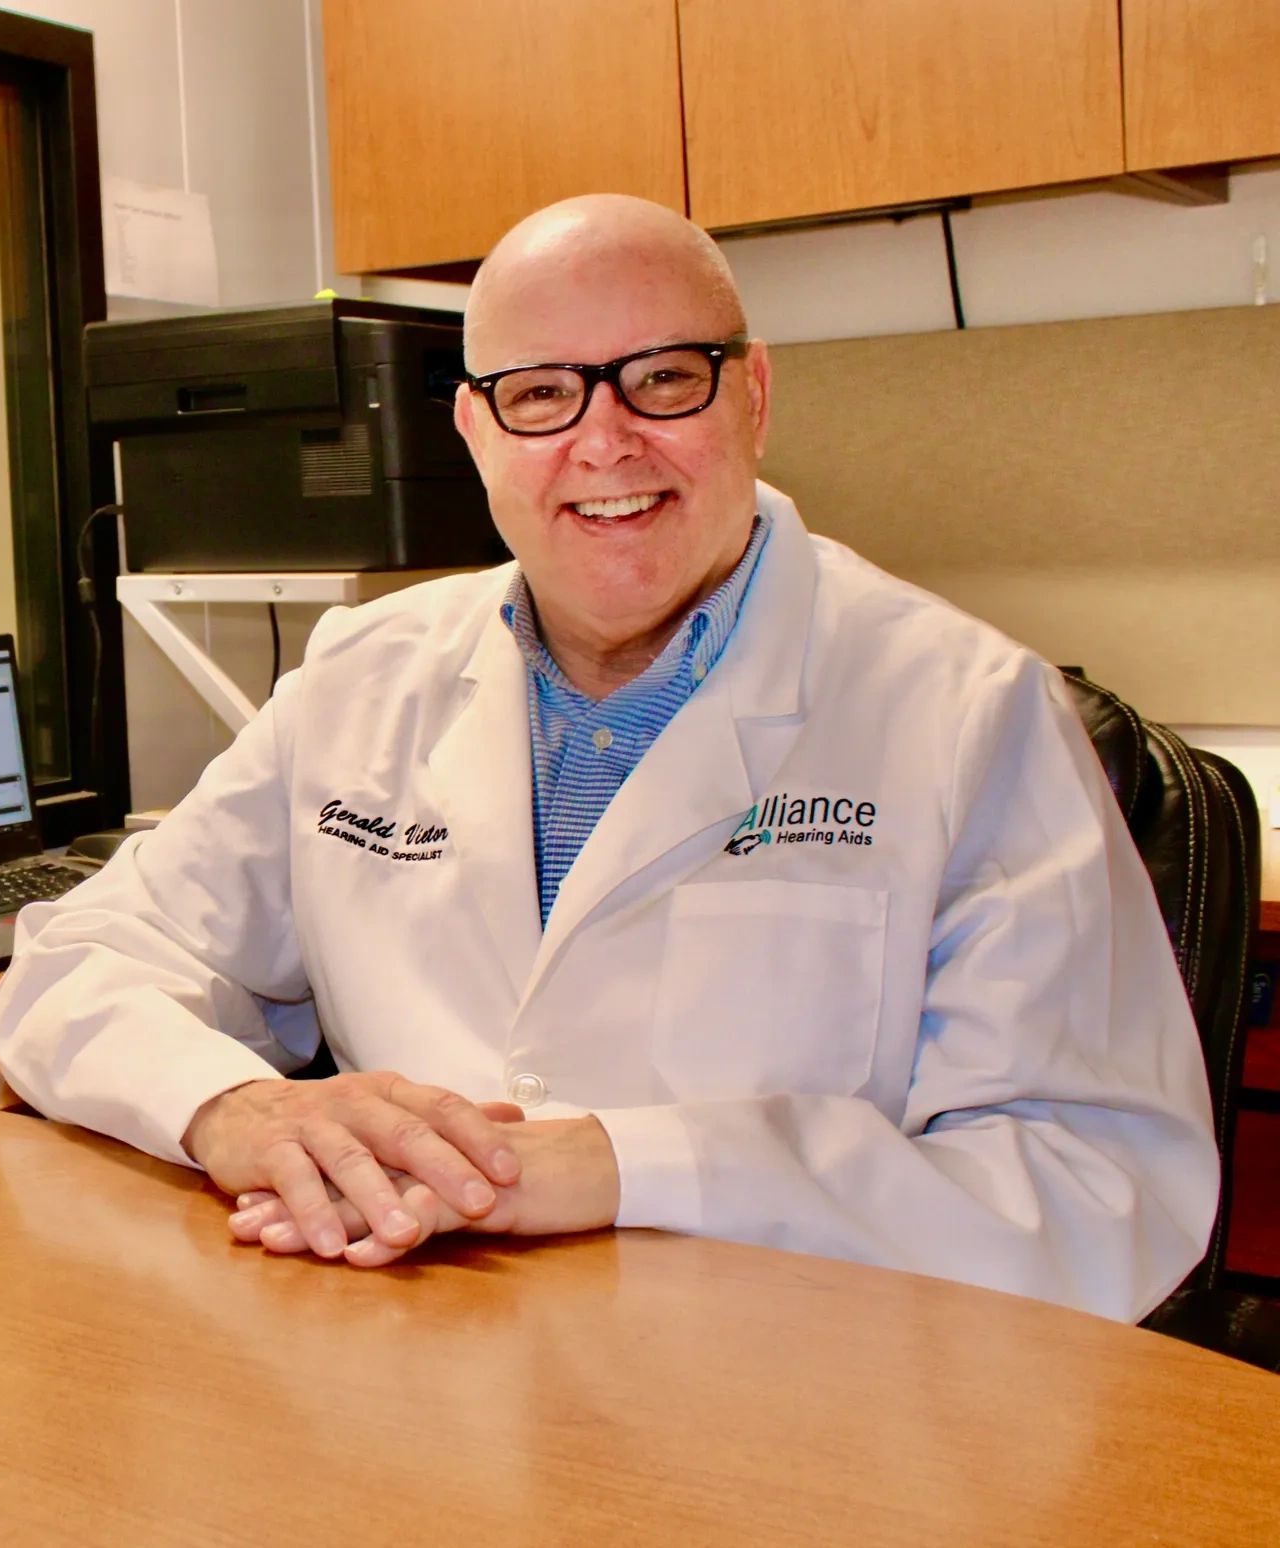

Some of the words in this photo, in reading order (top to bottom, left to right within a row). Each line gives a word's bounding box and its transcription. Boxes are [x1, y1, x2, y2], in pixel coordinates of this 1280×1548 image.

[318, 800, 396, 838] Gerald
[405, 823, 448, 845] Vietor
[731, 793, 876, 838] Alliance
[318, 826, 366, 848] HEARING
[369, 844, 389, 856] AID
[392, 850, 442, 861] SPECIALIST
[776, 828, 834, 845] Hearing
[838, 830, 872, 846] Aids
